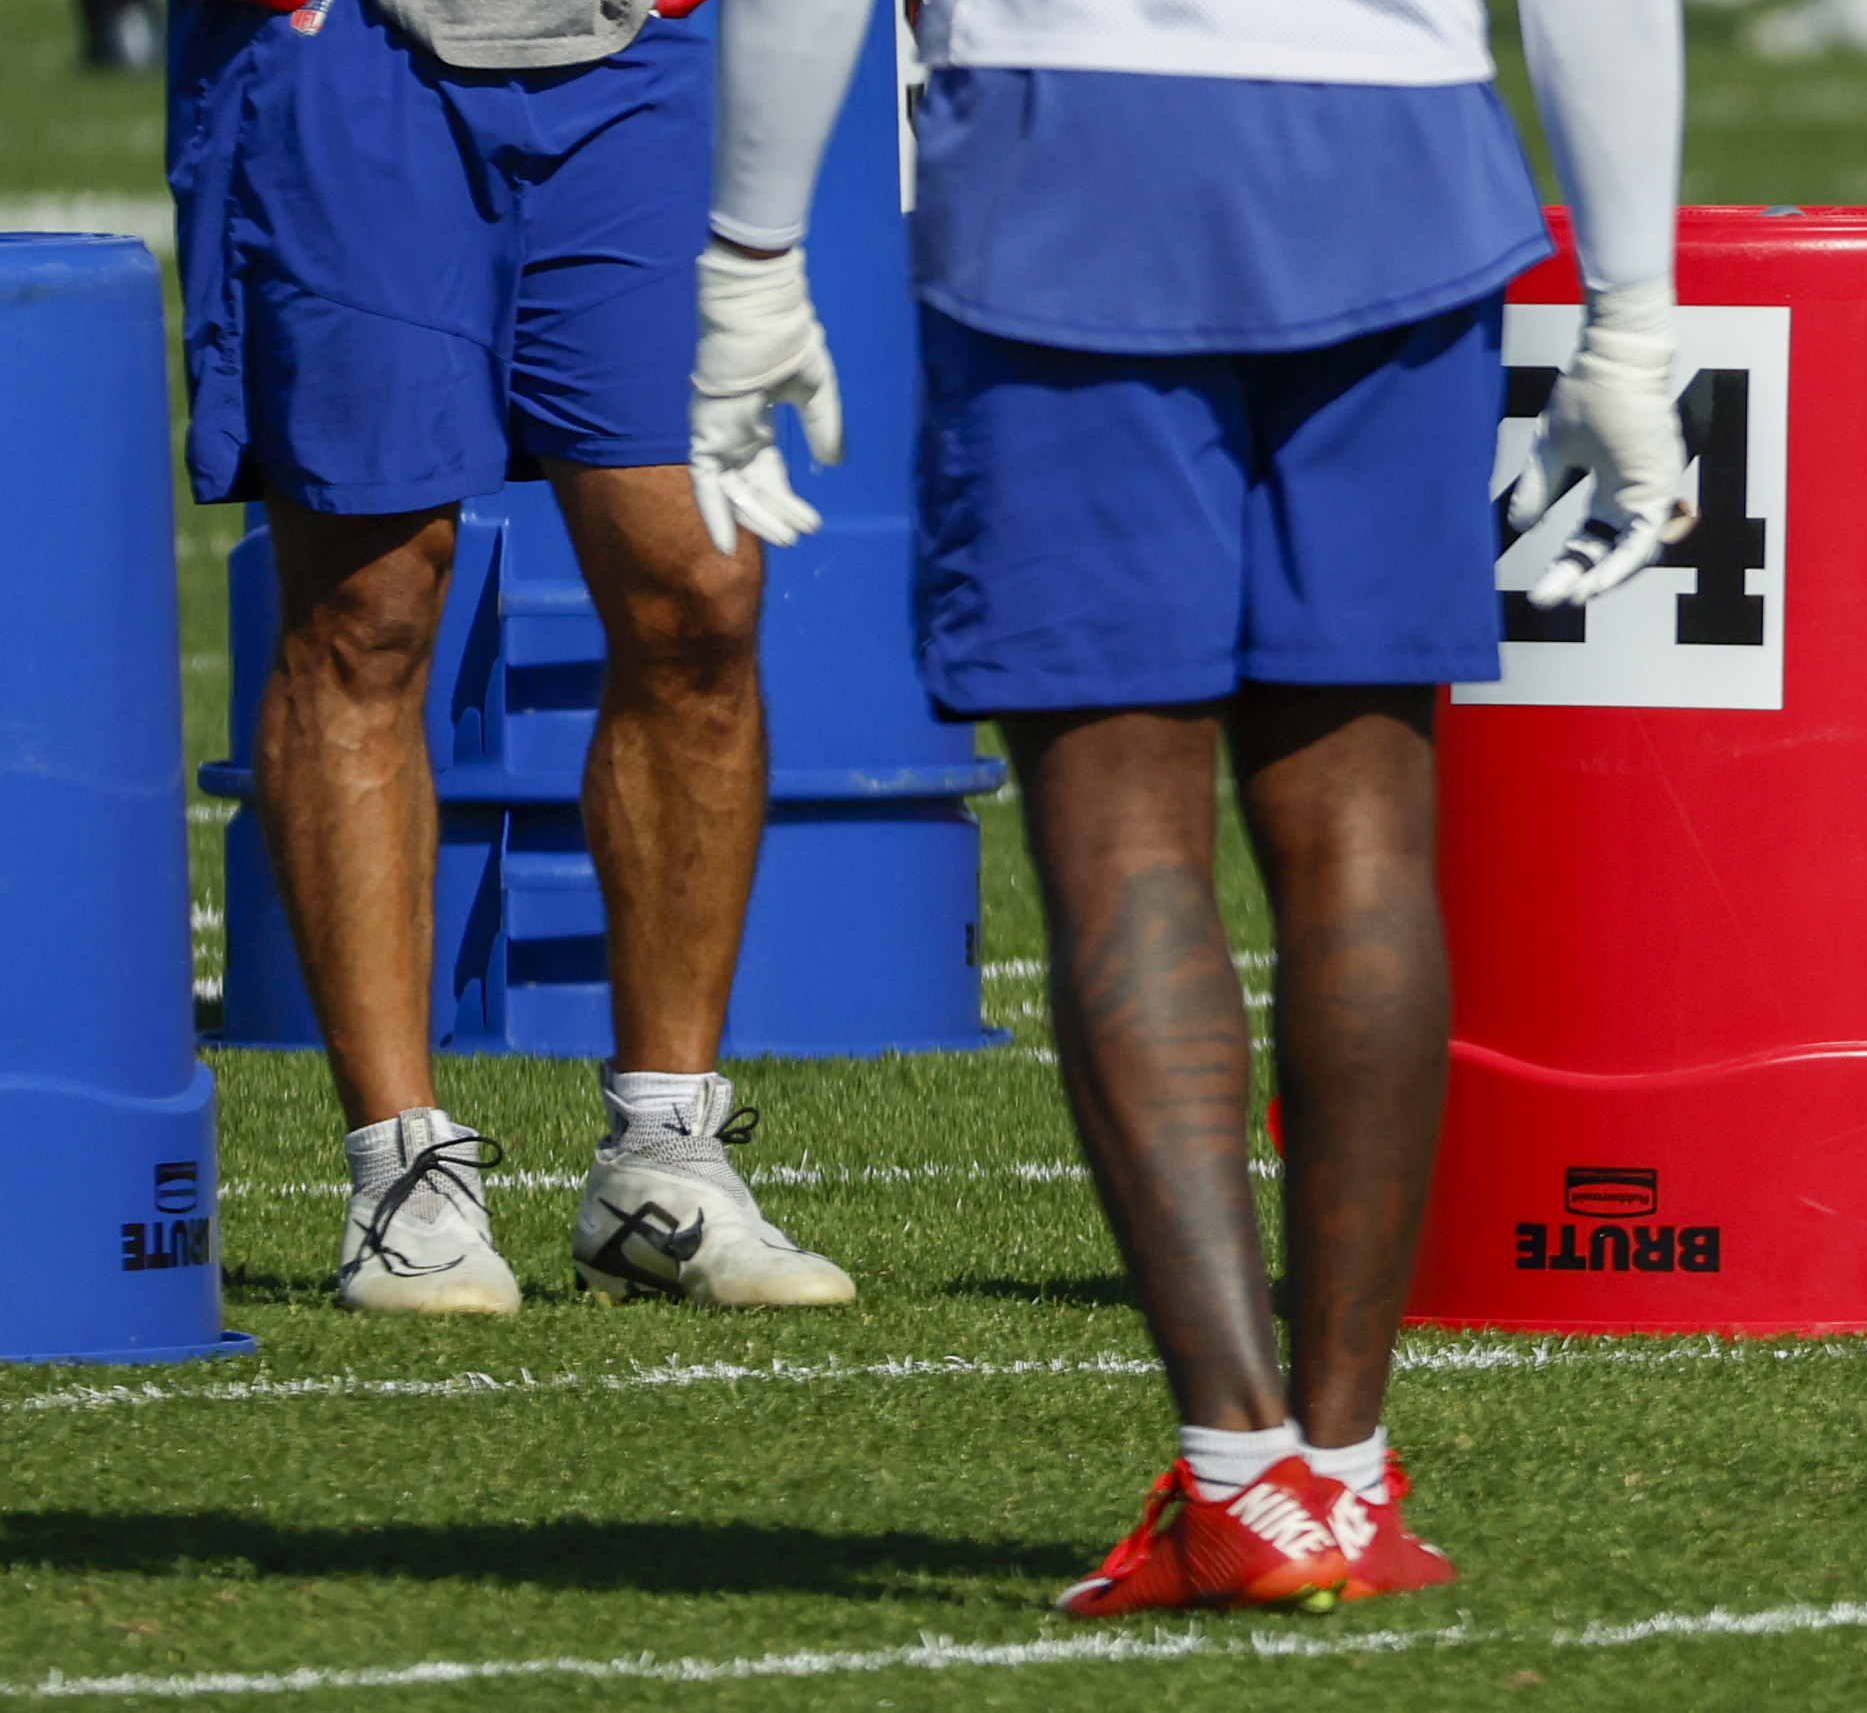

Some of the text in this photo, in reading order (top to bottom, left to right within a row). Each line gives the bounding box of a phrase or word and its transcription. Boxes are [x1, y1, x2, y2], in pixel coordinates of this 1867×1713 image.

[121, 1217, 210, 1272] RUTE
[1515, 1222, 1720, 1272] BRUTE
[1227, 1482, 1336, 1561] NIKE
